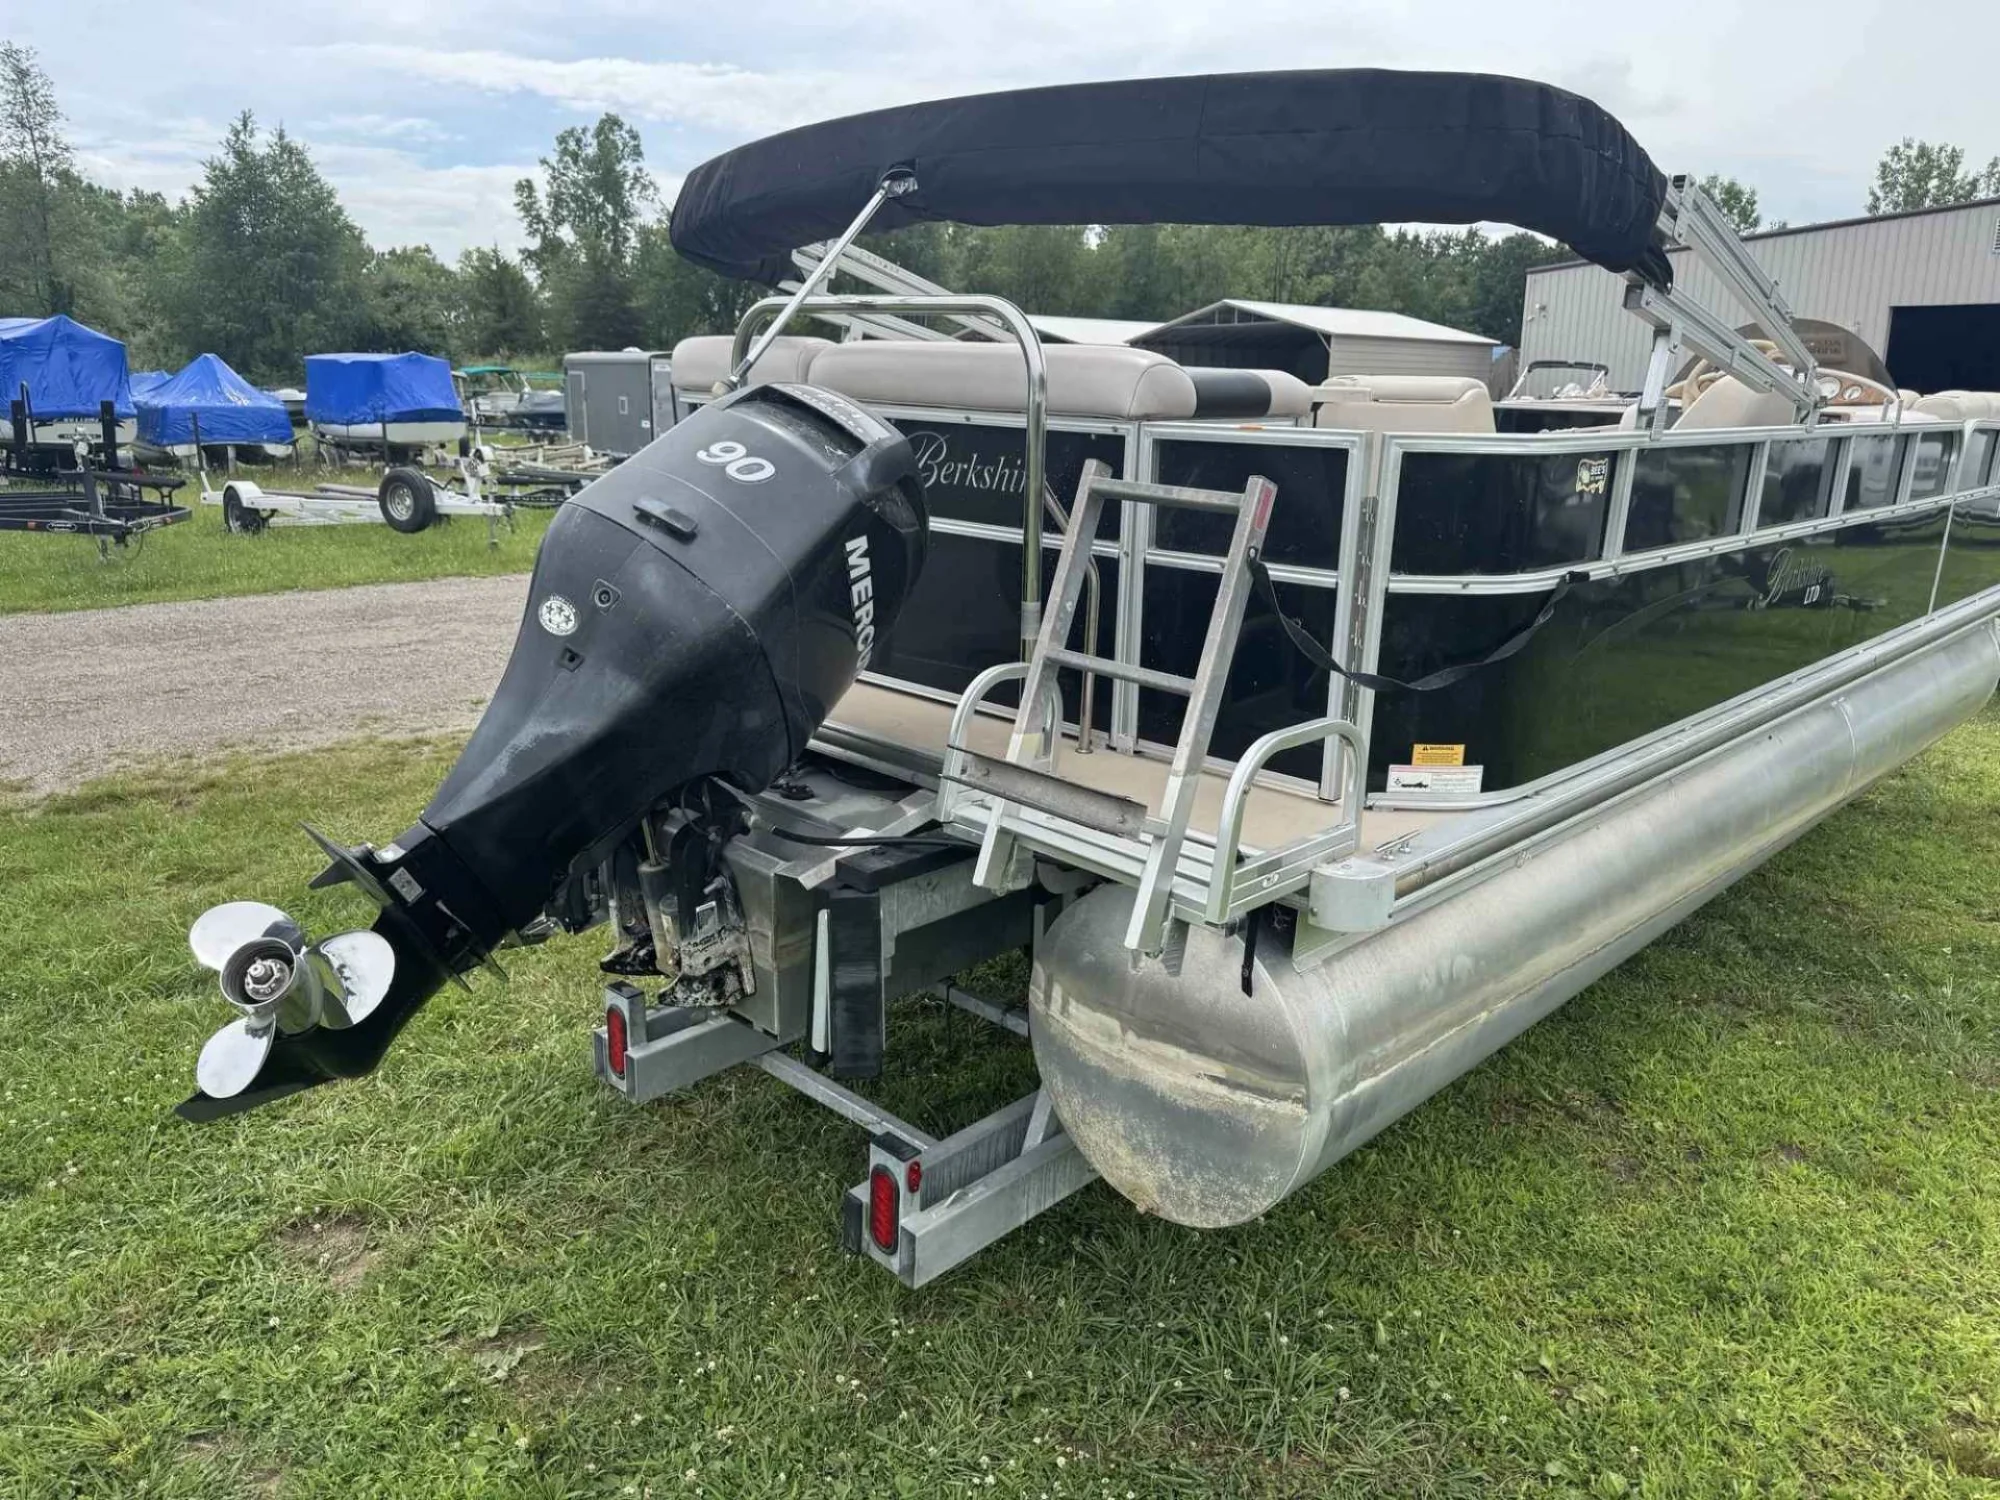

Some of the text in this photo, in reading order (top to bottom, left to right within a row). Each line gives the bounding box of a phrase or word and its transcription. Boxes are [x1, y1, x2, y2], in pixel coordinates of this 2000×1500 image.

[696, 440, 776, 484] 90
[907, 431, 1026, 493] Berkshi
[845, 535, 876, 674] MERCU
[1803, 585, 1820, 605] LTD
